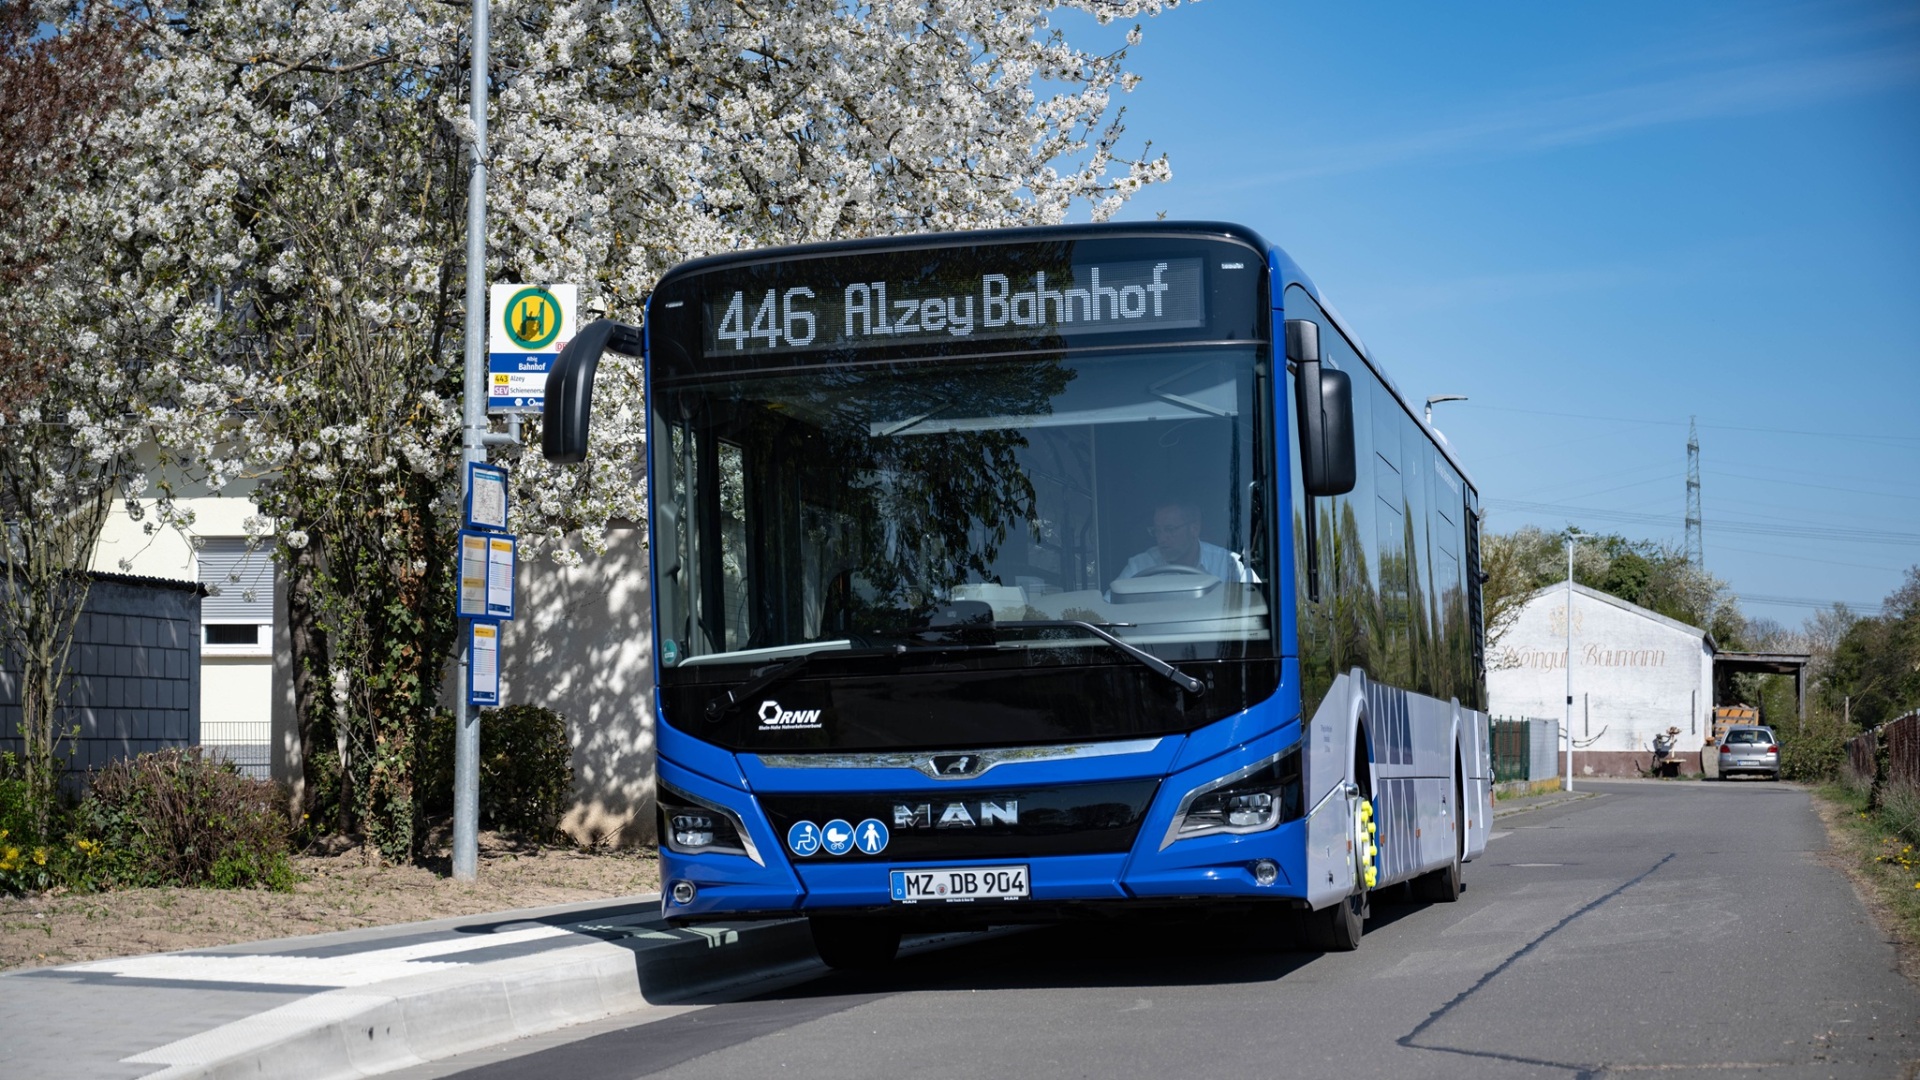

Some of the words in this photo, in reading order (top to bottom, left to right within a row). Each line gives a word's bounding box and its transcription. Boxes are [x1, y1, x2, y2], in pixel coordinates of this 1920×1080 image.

[521, 301, 545, 336] H
[717, 286, 816, 350] 446
[845, 280, 974, 336] Alzey
[983, 262, 1169, 328] Bahnhof
[494, 375, 509, 383] 443
[518, 362, 547, 371] Bahnhof
[494, 387, 509, 395] SEV
[1580, 643, 1666, 669] Baumann
[779, 710, 821, 724] RNN
[893, 800, 1019, 829] MAN
[906, 874, 935, 896] MZ
[950, 872, 978, 894] DB
[983, 871, 1025, 893] 904
